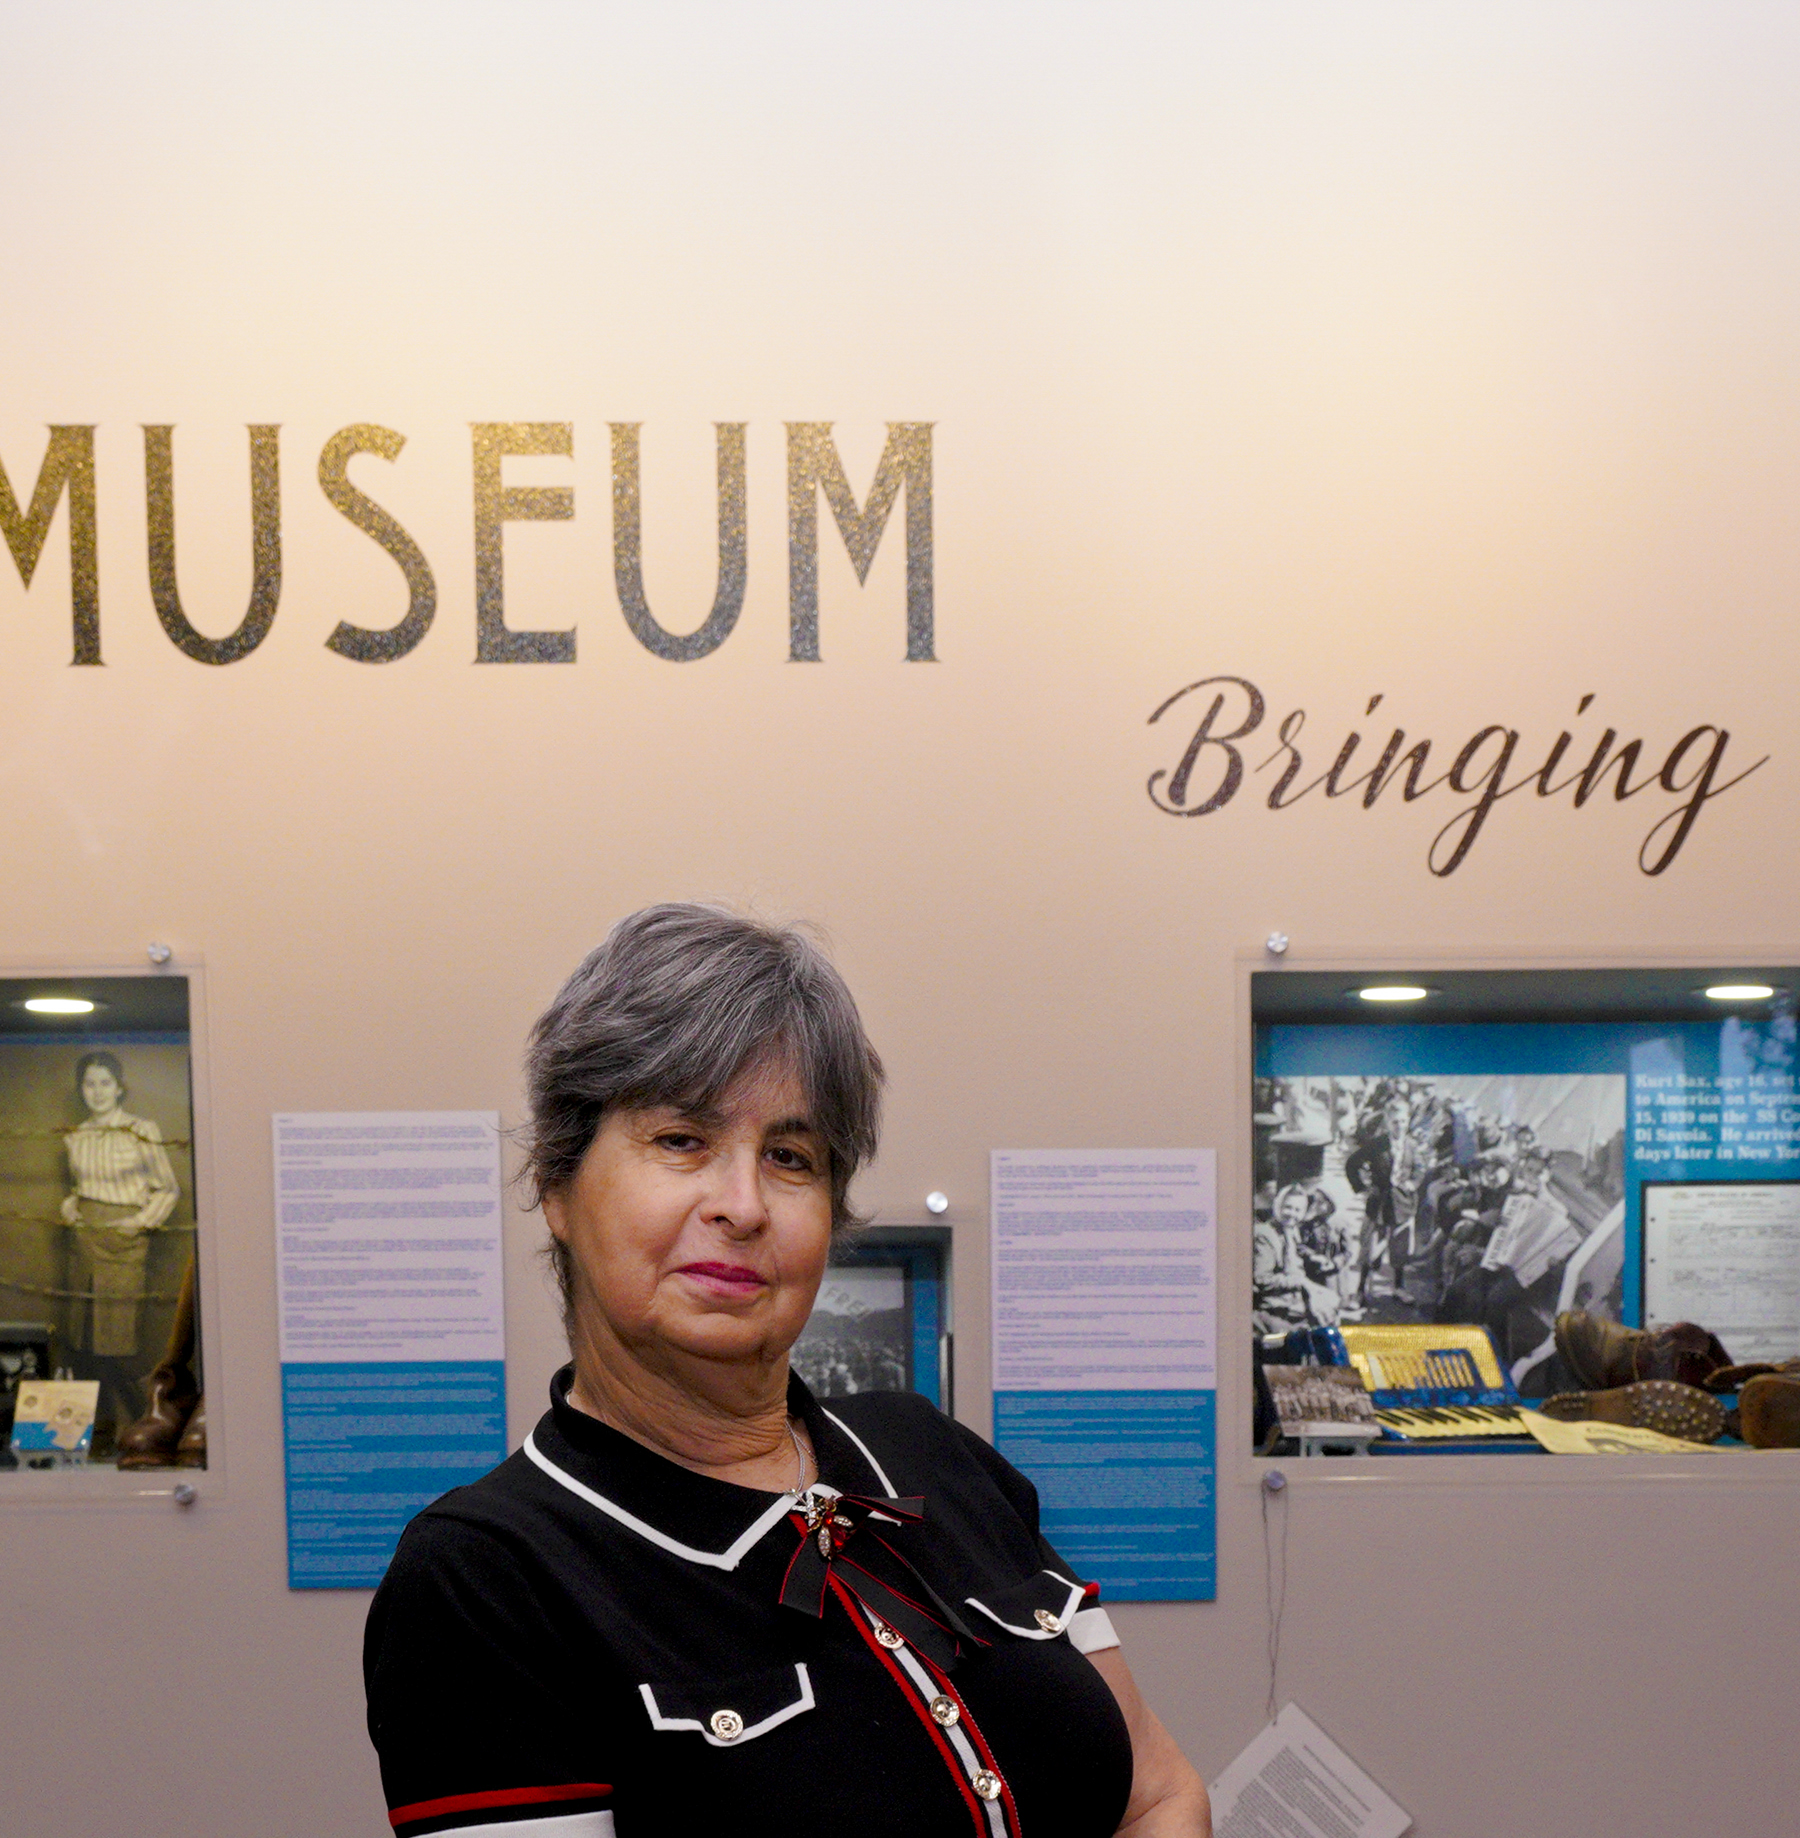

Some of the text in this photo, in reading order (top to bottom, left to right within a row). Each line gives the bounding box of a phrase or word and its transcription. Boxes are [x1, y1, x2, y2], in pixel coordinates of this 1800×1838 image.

[1146, 675, 1770, 879] Bringing
[1715, 1077, 1743, 1090] age
[1773, 1075, 1795, 1087] set
[1635, 1094, 1651, 1105] to
[1655, 1092, 1721, 1106] America
[1725, 1095, 1745, 1105] on
[1635, 1111, 1656, 1124] 15,
[1698, 1113, 1718, 1123] on
[1723, 1110, 1748, 1123] the
[1635, 1128, 1652, 1142] Di
[1721, 1128, 1743, 1141] He
[1634, 1147, 1670, 1163] days
[1675, 1146, 1713, 1160] later
[1717, 1146, 1733, 1159] in
[1738, 1146, 1771, 1159] New
